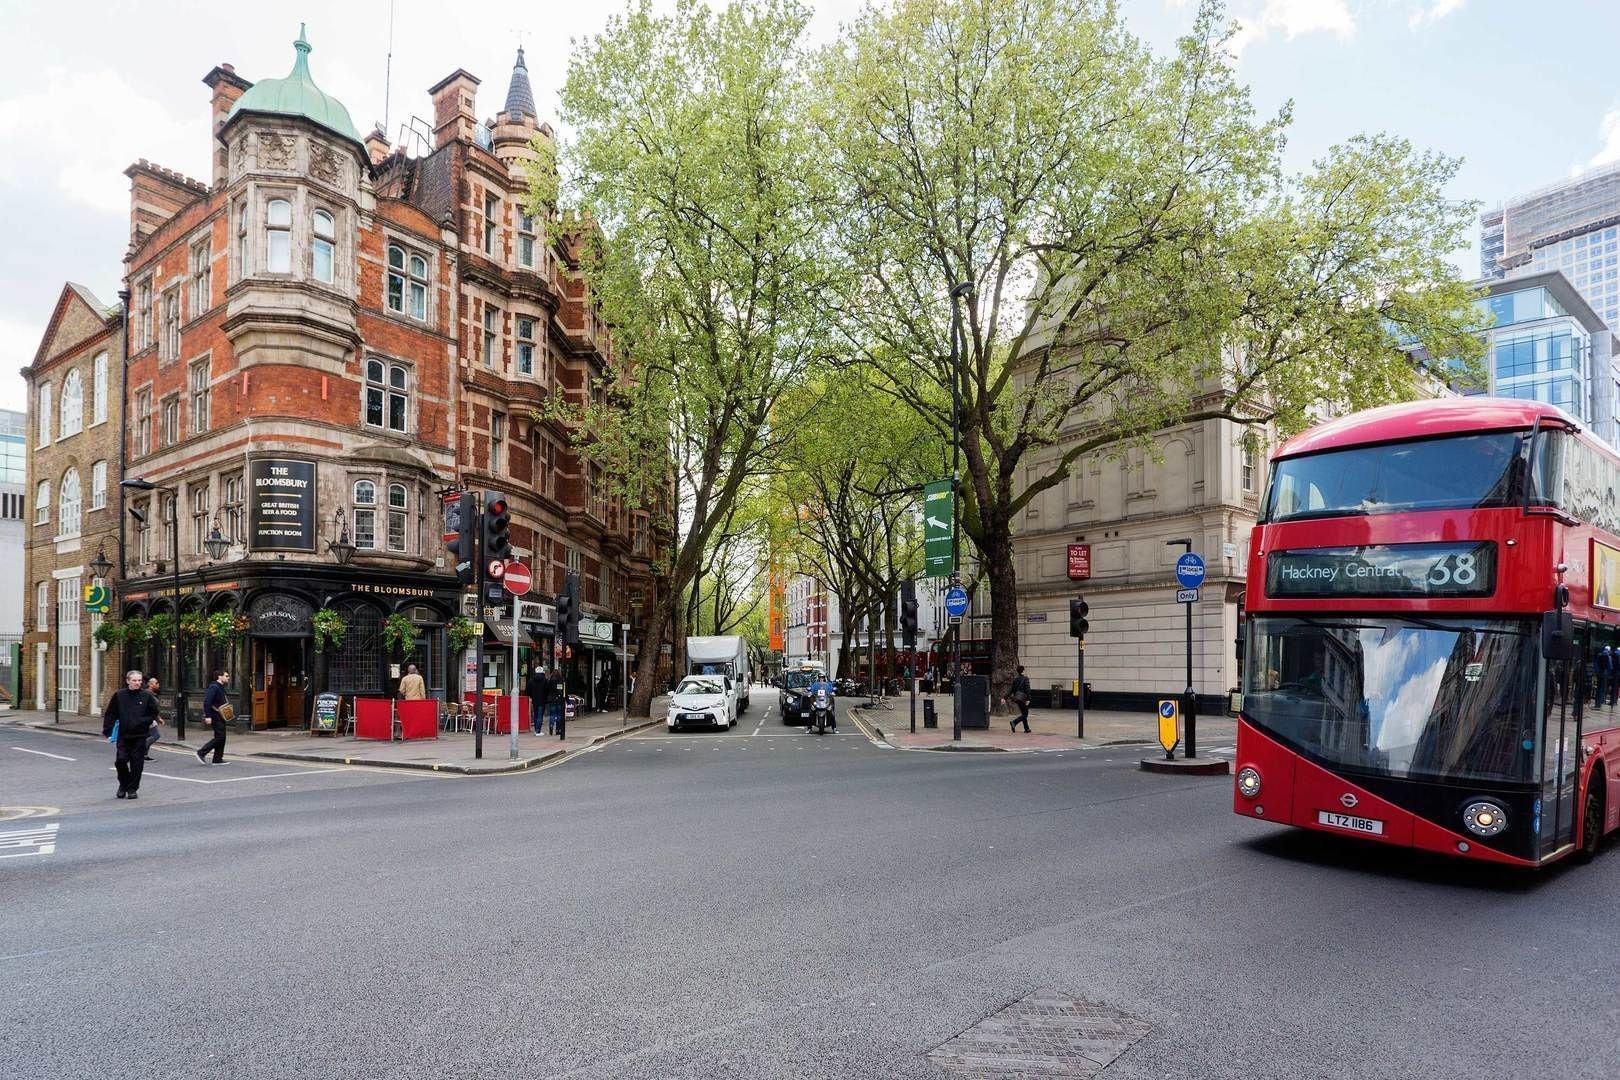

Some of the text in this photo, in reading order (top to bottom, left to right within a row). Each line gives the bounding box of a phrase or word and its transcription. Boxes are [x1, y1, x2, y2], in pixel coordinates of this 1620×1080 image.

[271, 467, 288, 475] THE
[256, 478, 307, 488] BLOOMSBURY
[1282, 553, 1476, 586] Hackney Central 38
[352, 584, 434, 596] THE BLOOMSBURY
[1328, 814, 1372, 830] LTZ 1186
